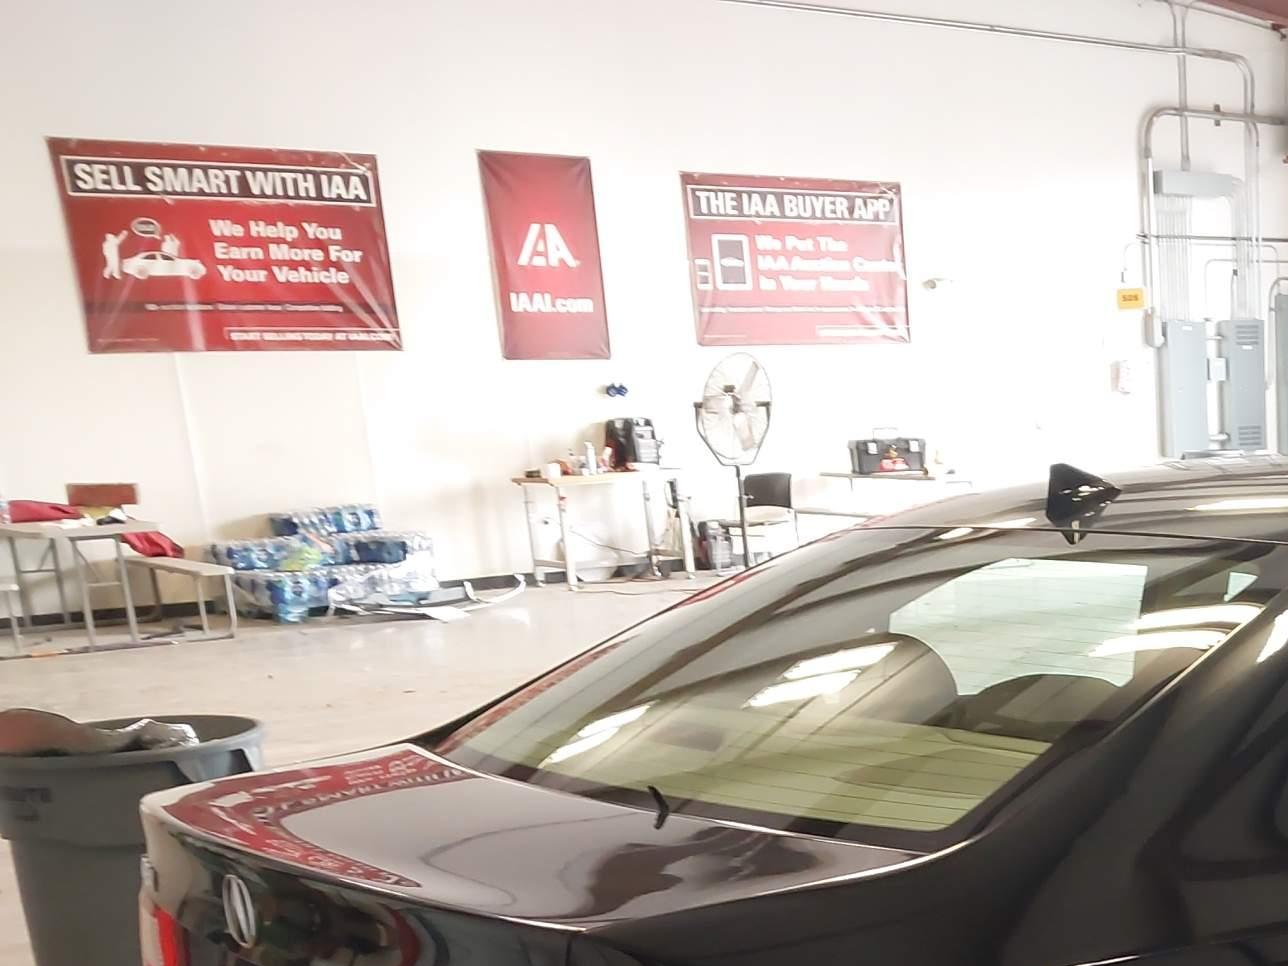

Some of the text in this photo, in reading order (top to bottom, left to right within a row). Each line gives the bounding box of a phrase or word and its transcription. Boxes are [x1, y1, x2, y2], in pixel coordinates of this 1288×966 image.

[74, 163, 368, 201] SELL SMART WITH IAA
[695, 190, 890, 220] THE IAA BUYER APP
[209, 219, 342, 242] We Help You
[213, 242, 363, 264] Earn More For
[217, 265, 350, 285] Your Vehicle
[509, 292, 594, 313] IAAI.com
